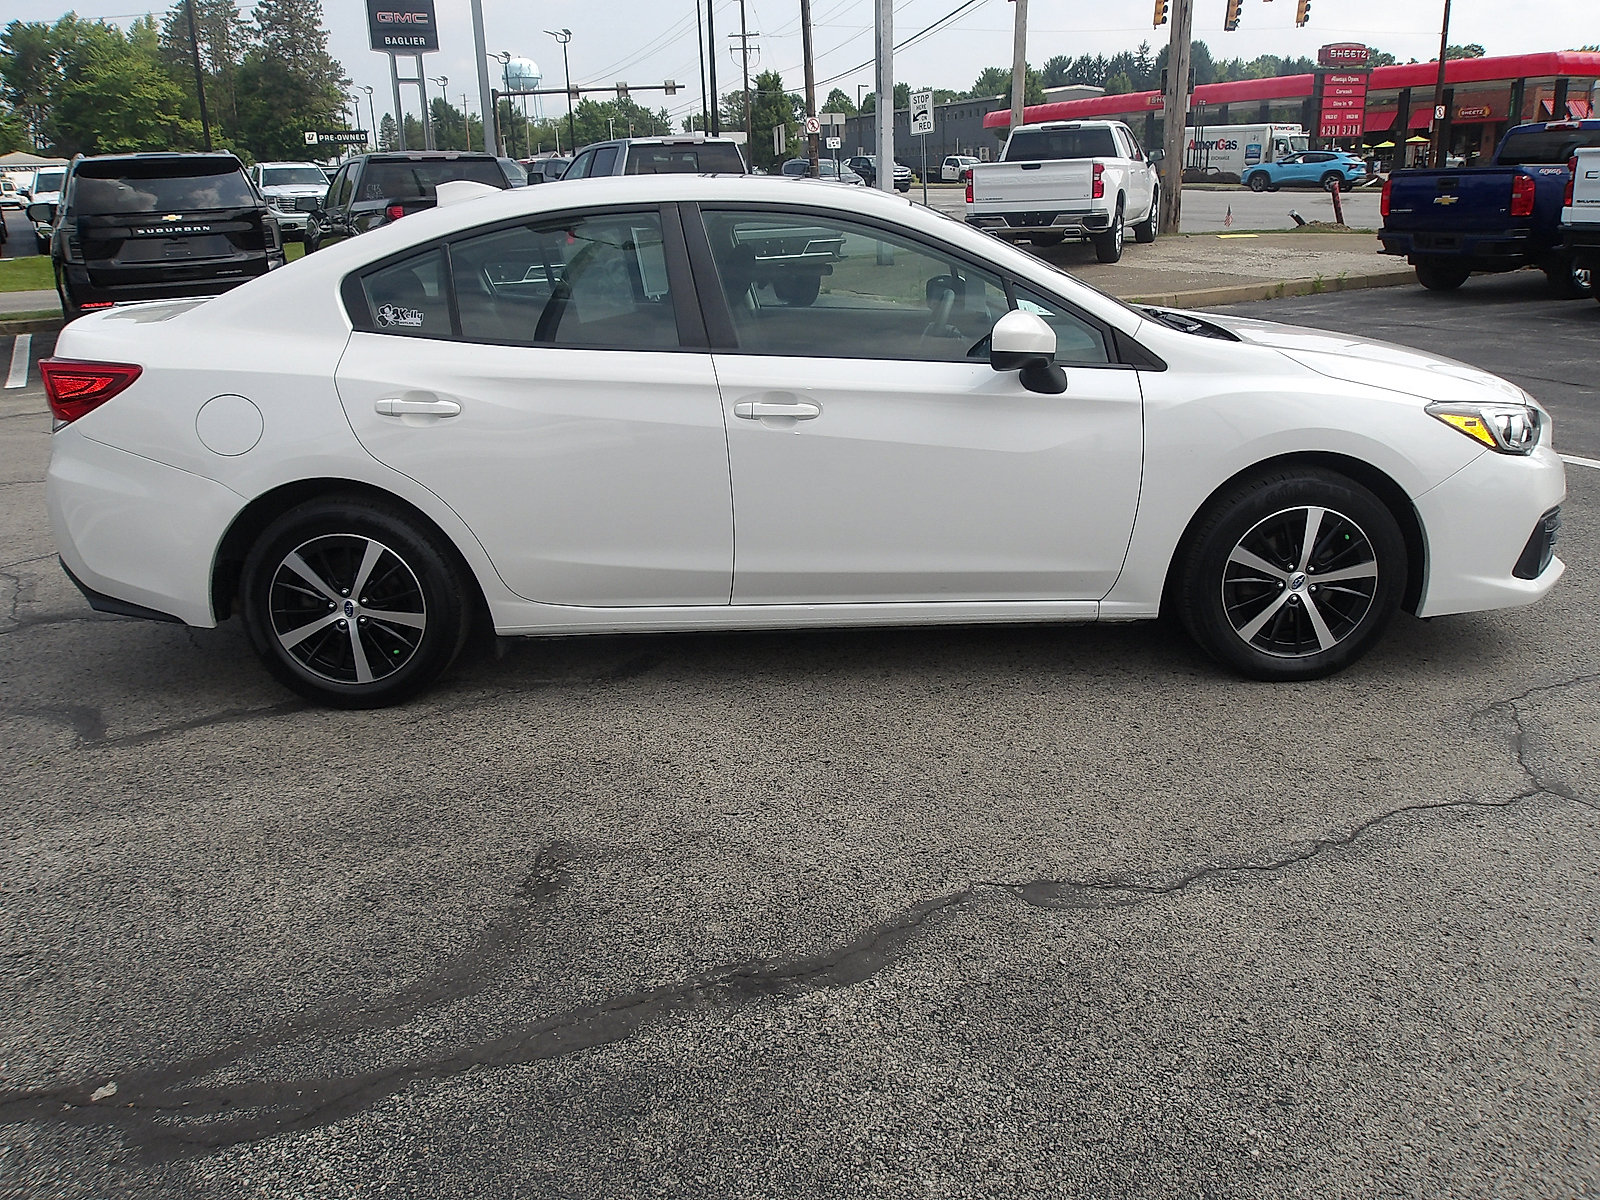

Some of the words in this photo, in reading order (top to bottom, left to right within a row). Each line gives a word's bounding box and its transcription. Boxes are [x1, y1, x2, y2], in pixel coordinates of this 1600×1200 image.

[376, 12, 428, 23] GMC
[385, 37, 425, 45] BAGLIER
[1330, 50, 1366, 59] SHEETZ
[913, 95, 929, 105] STOP
[919, 122, 931, 130] RED
[319, 133, 366, 142] PRE-OWNED
[1188, 138, 1238, 151] AmeriGas
[137, 225, 211, 234] SUBURBAN
